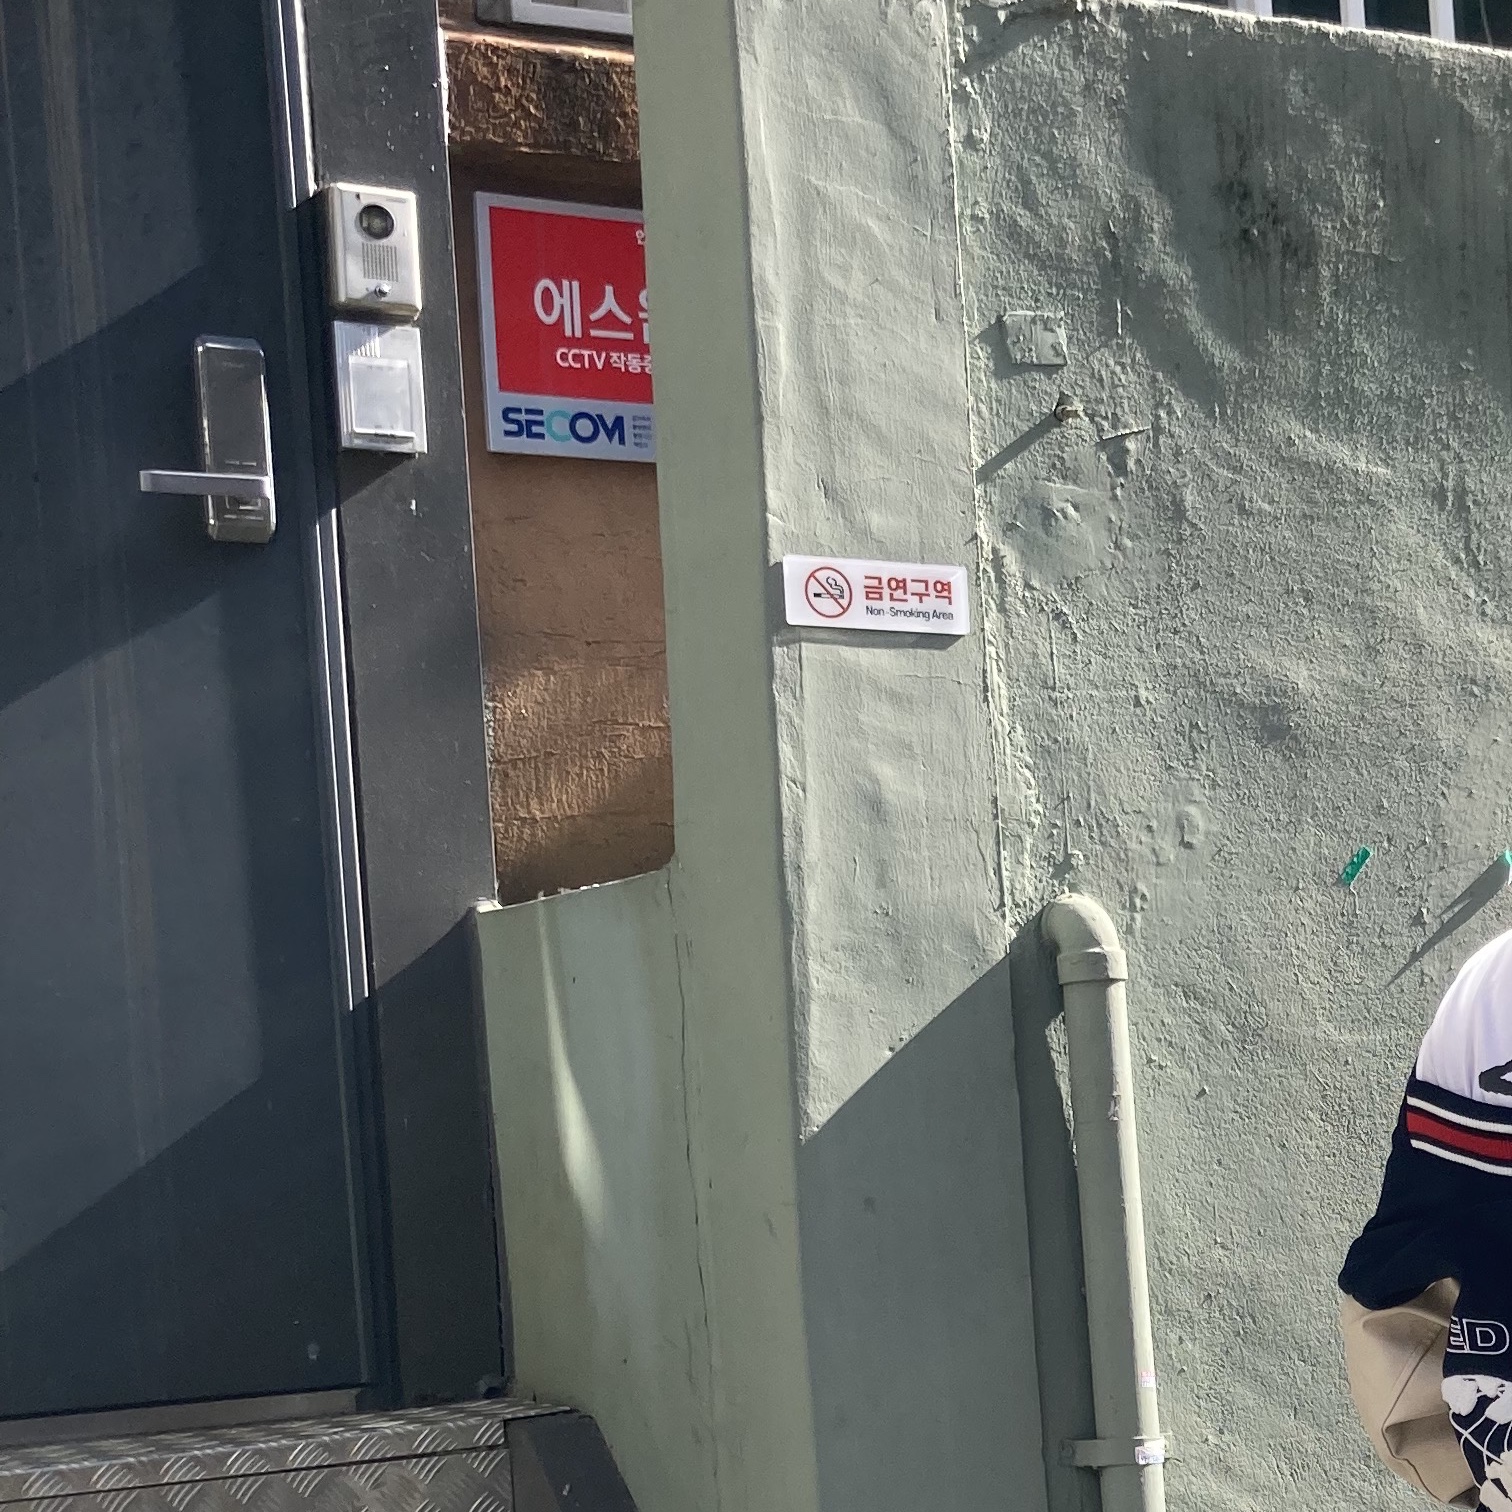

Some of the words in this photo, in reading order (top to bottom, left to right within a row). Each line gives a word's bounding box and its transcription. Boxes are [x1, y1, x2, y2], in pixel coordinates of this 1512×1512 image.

[556, 347, 606, 371] CCTV
[502, 406, 626, 447] SECOM
[863, 575, 952, 605] 금연구역
[931, 609, 954, 620] Area
